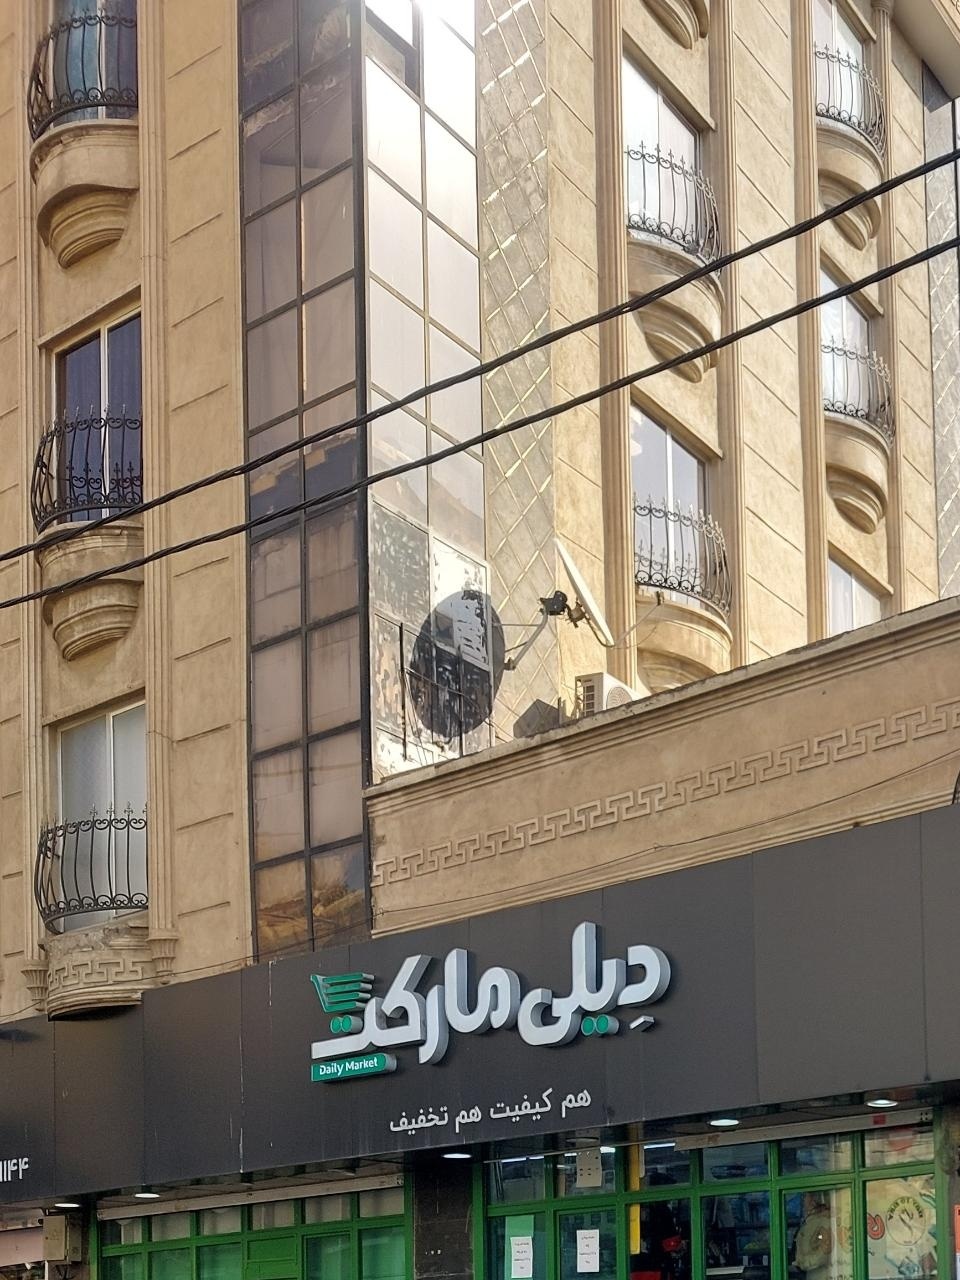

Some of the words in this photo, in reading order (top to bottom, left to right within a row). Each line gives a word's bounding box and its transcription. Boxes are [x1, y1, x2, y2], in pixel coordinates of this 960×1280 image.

[311, 948, 522, 1065] مارکت
[319, 1063, 344, 1076] Daily
[345, 1057, 378, 1071] Market
[490, 1088, 553, 1123] کیفیت
[561, 1089, 592, 1117] هم
[390, 1106, 449, 1136] تخفیف
[455, 1106, 482, 1133] هم
